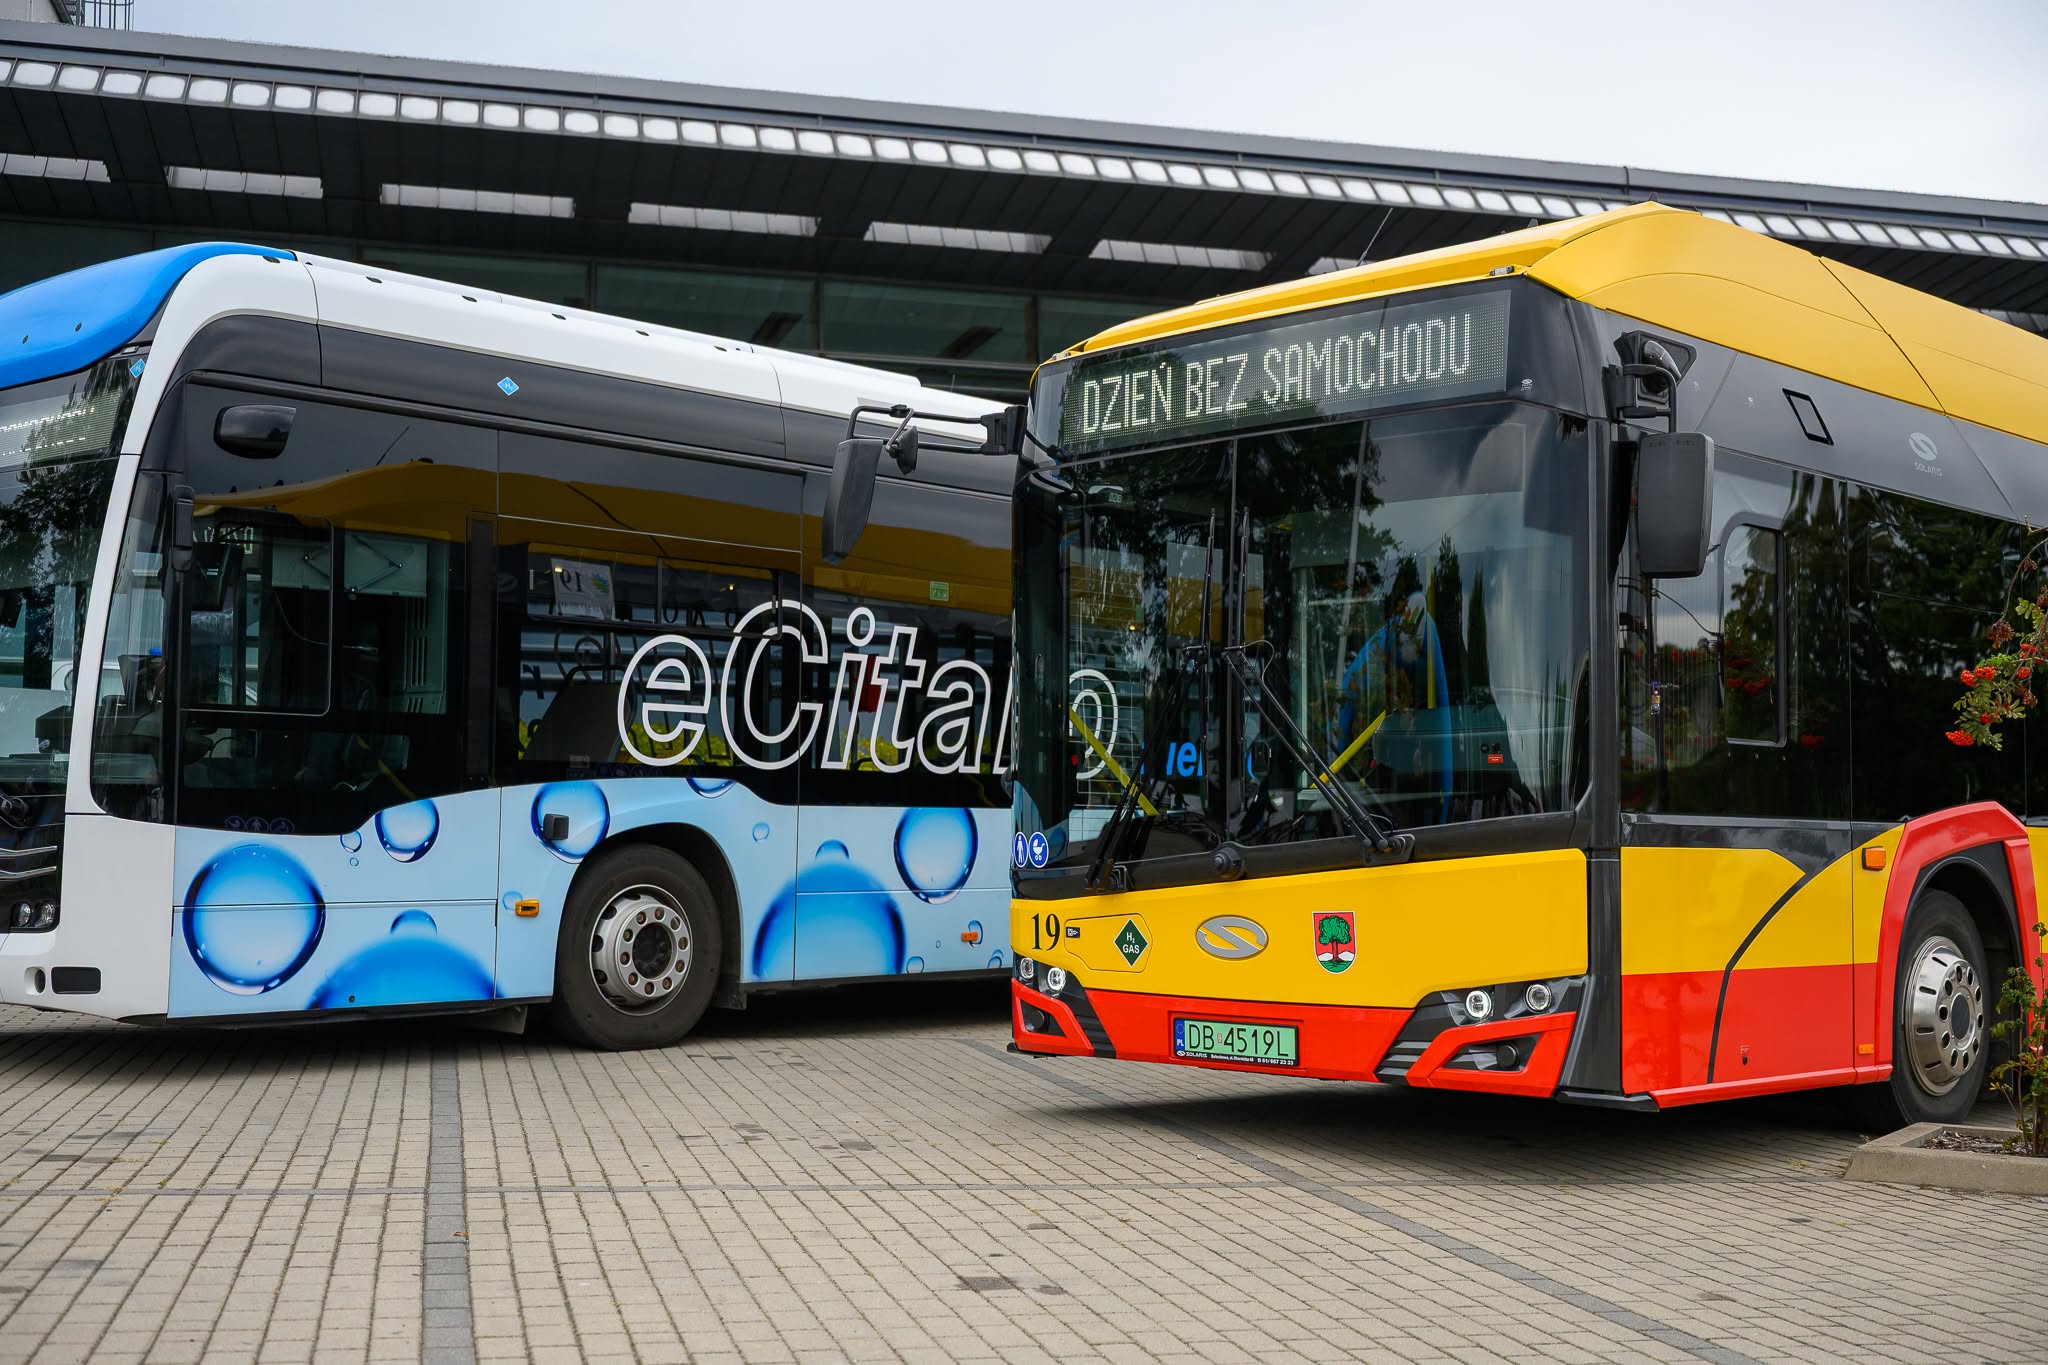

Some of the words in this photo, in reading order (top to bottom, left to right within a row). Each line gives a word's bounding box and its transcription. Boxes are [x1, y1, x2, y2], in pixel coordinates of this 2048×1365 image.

[1083, 361, 1172, 434] DZIEŃ
[1185, 353, 1249, 418] BEZ
[1263, 313, 1471, 405] SAMOCHODU
[1914, 461, 1943, 477] SOLARIS
[616, 599, 1119, 780] eCitao
[1031, 912, 1060, 951] 19
[1122, 944, 1140, 954] GAS
[1176, 1038, 1184, 1047] PL
[1188, 1023, 1215, 1051] DB
[1223, 1026, 1289, 1058] 4519L
